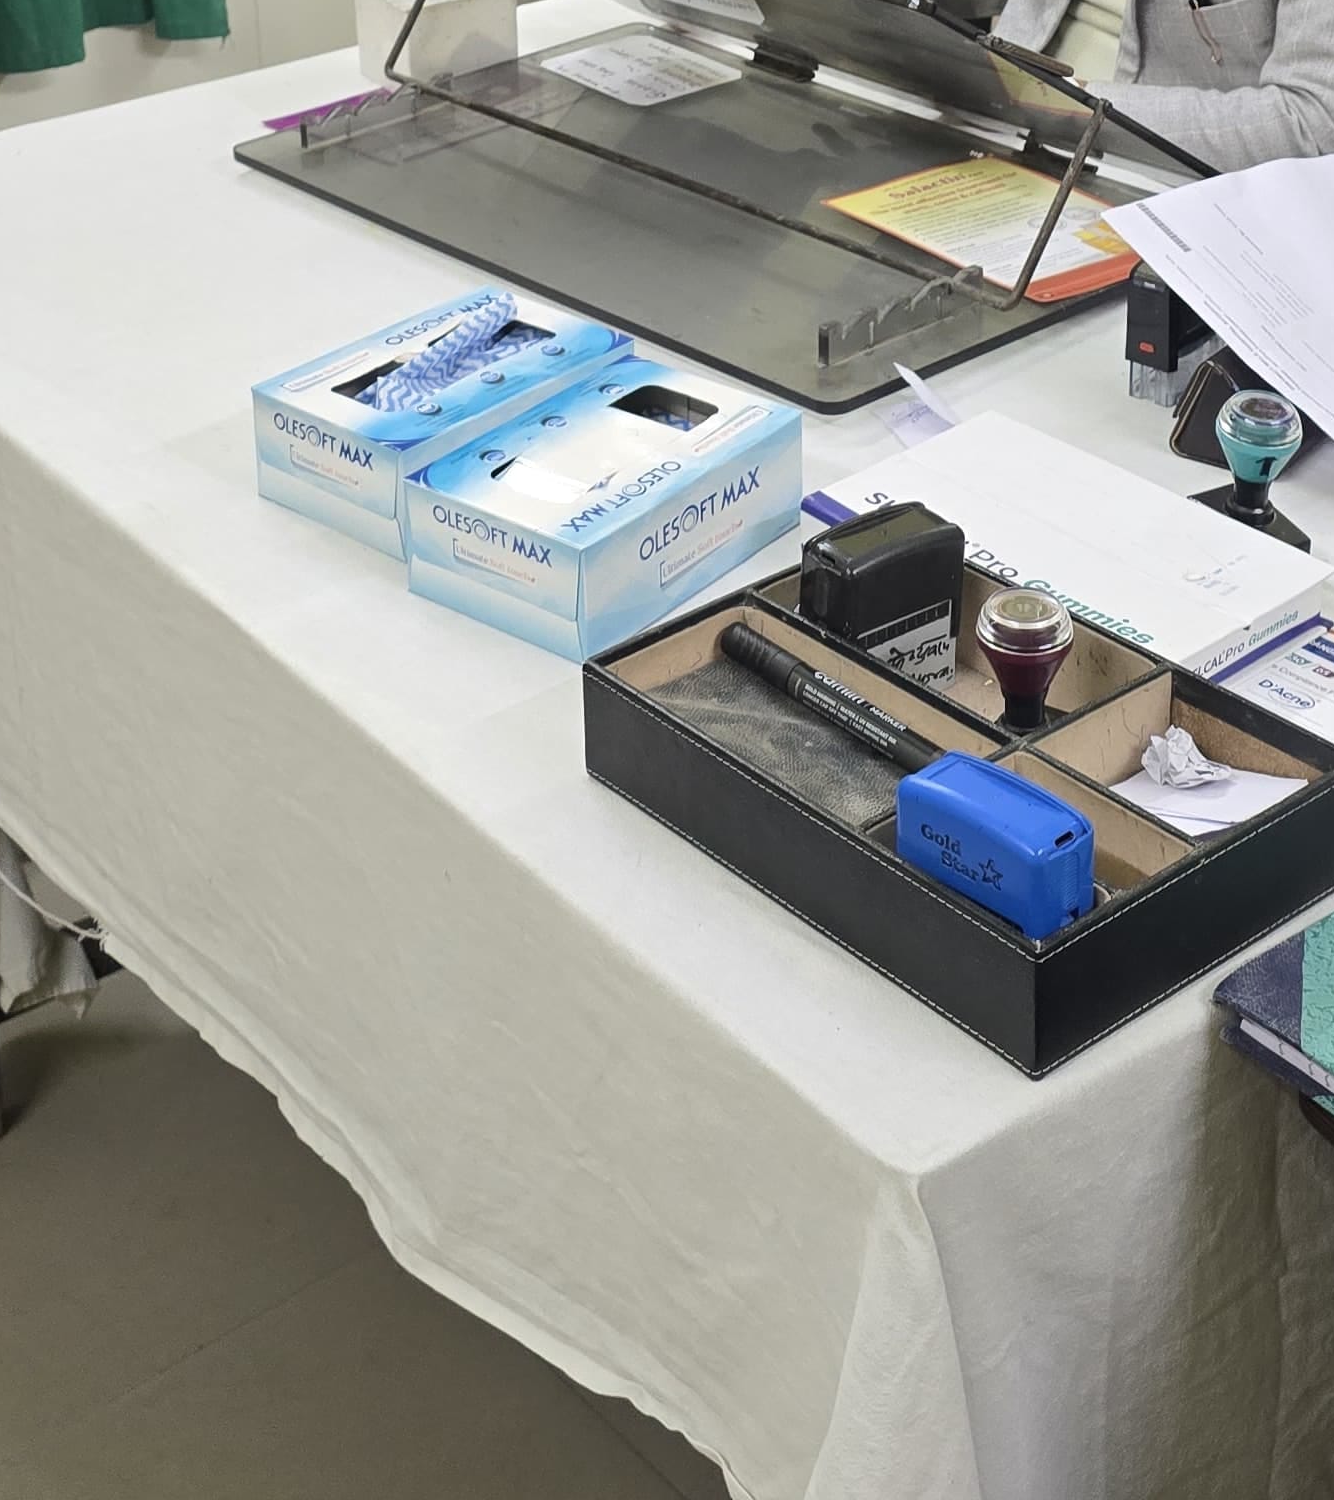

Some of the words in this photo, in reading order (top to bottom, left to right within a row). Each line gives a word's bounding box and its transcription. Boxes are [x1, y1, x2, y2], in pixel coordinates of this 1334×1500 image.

[273, 412, 337, 448] OLESOFT
[339, 440, 374, 471] MAX
[614, 460, 682, 508] OLESOFT
[561, 503, 610, 532] MAX
[639, 492, 717, 561] OLESOFT
[720, 465, 760, 511] MAX
[433, 504, 507, 549] OLESOFT
[512, 535, 553, 568] MAX
[1248, 610, 1299, 647] Gummies
[1258, 678, 1311, 709] D'Acne
[920, 823, 963, 856] Gold
[940, 851, 980, 882] Star
